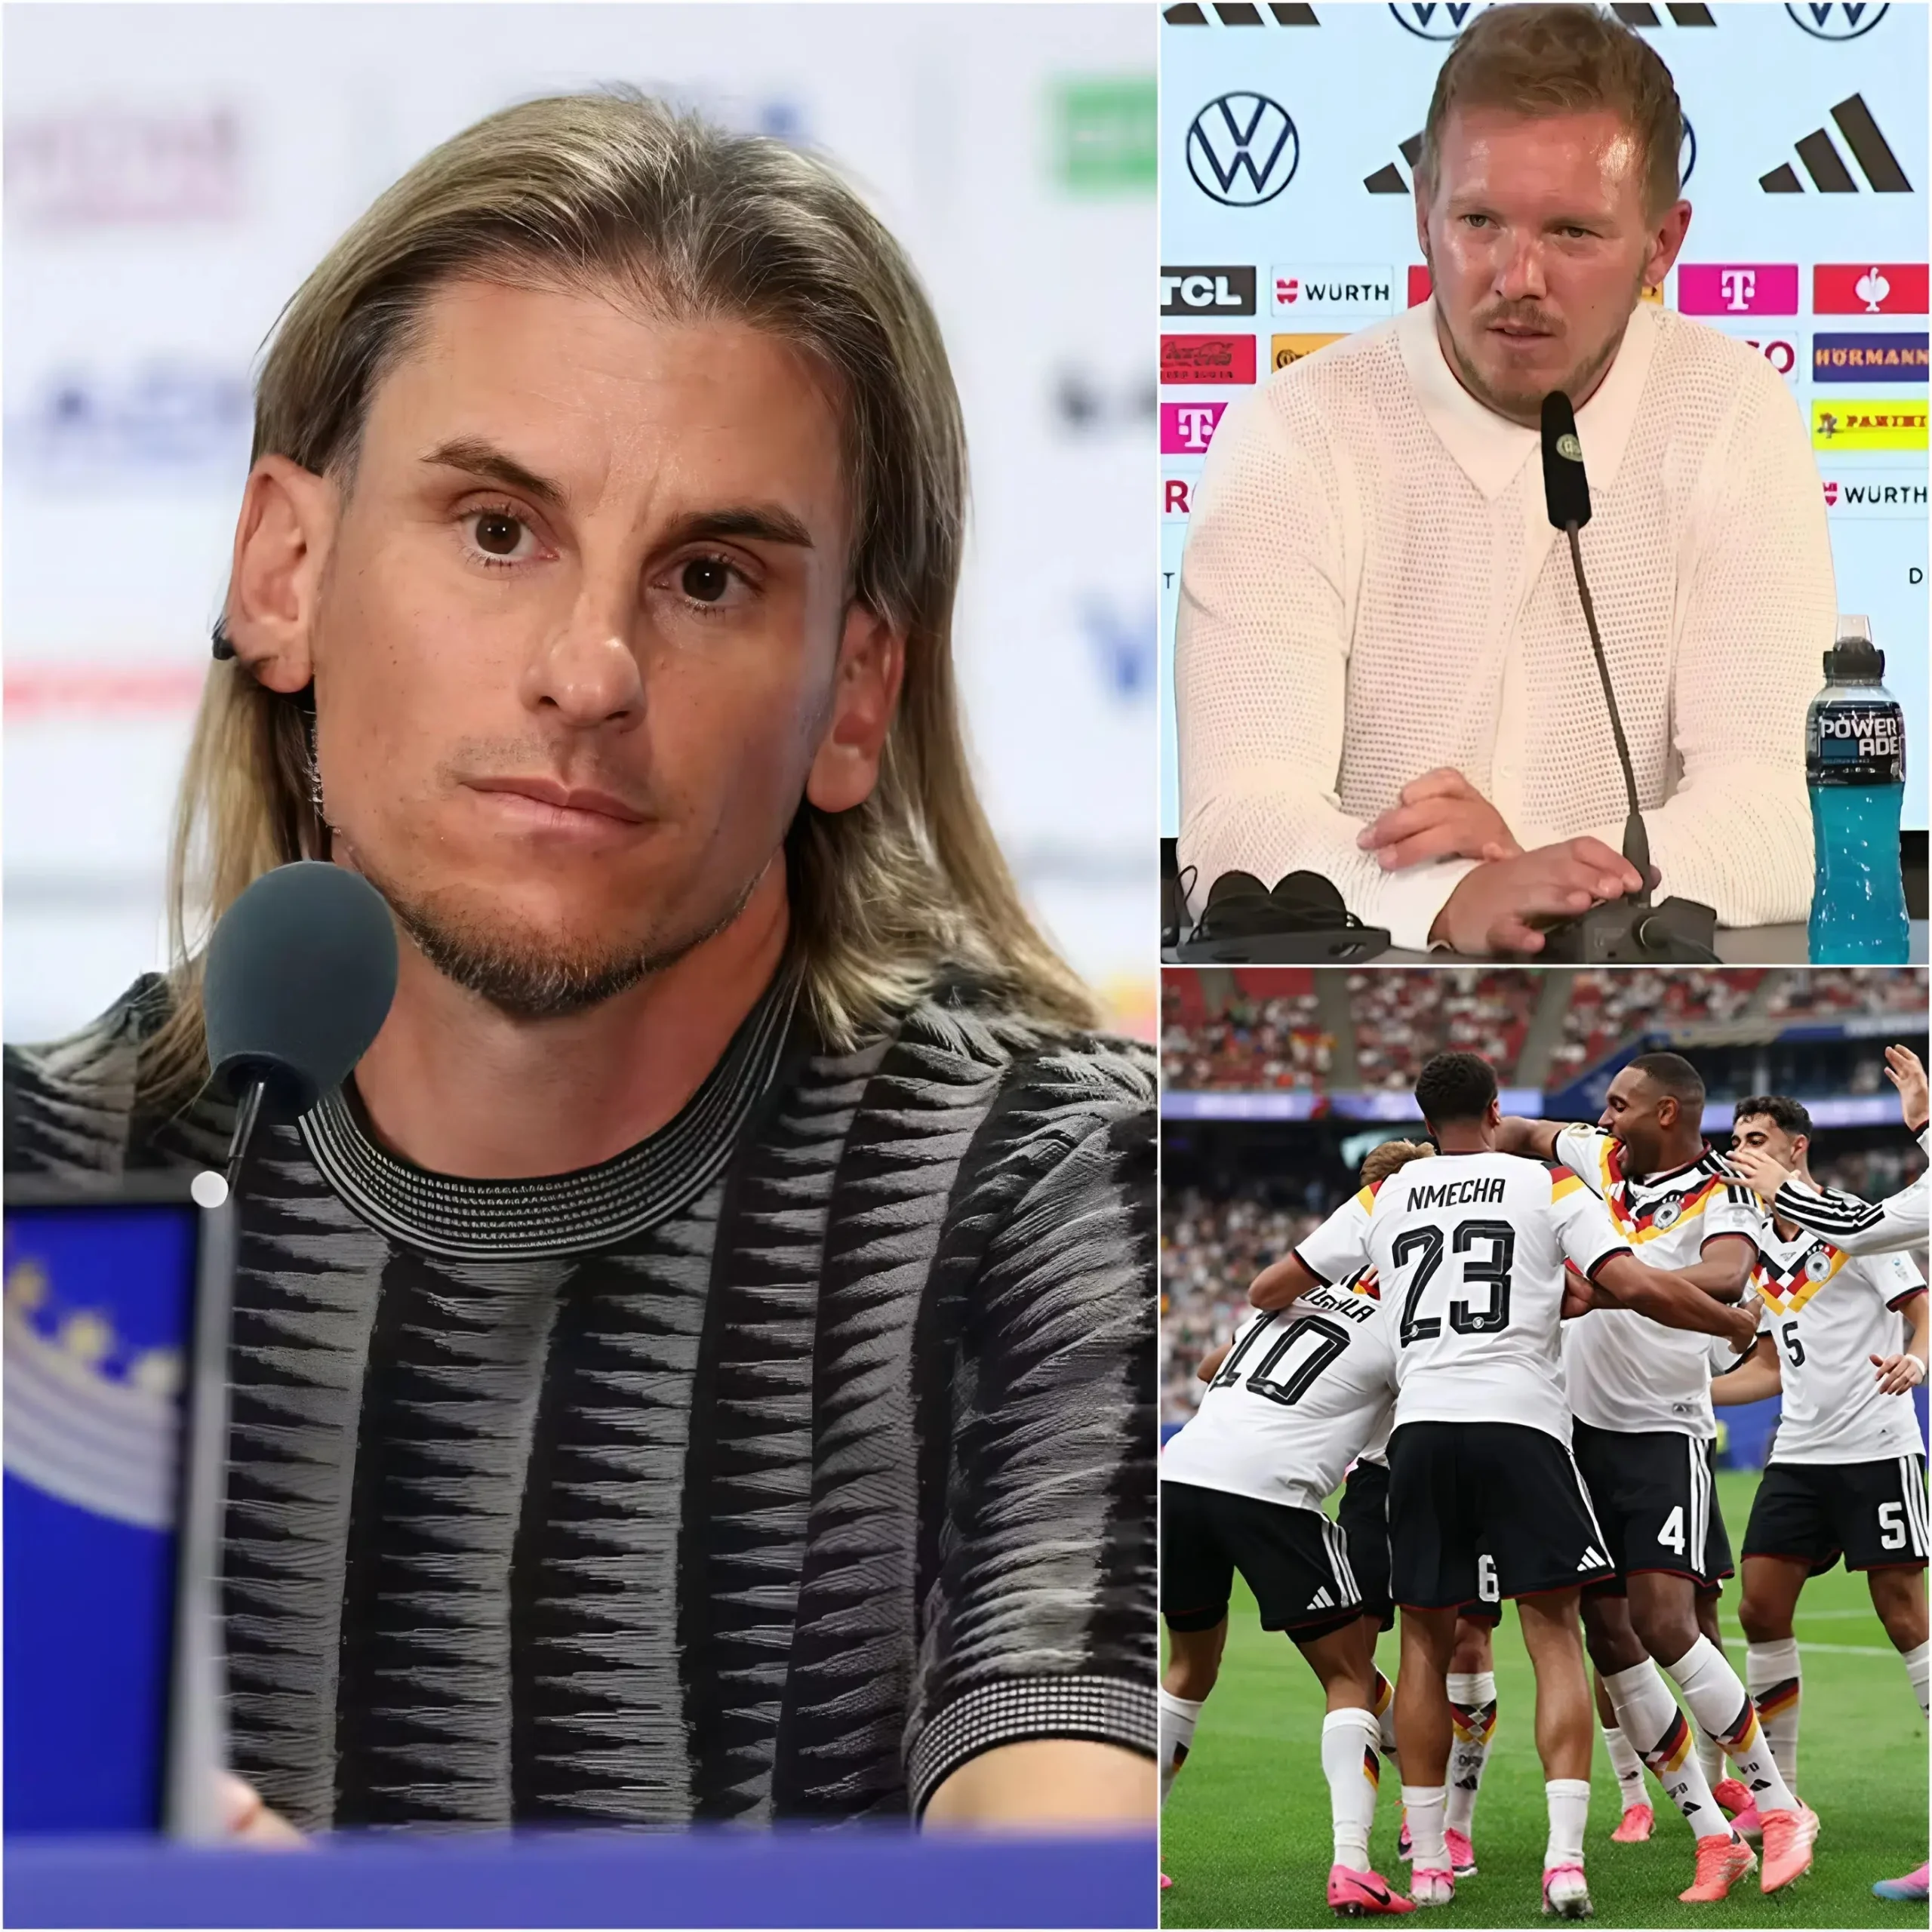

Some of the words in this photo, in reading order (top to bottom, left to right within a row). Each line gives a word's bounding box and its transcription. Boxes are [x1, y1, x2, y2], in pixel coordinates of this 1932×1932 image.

[1161, 275, 1241, 307] TCL
[1820, 717, 1897, 738] POWER
[1859, 737, 1900, 756] ADE
[1407, 1177, 1506, 1212] NMECHA
[1392, 1219, 1515, 1349] 23
[1208, 1309, 1351, 1406] 10
[1782, 1321, 1806, 1367] 5
[1657, 1506, 1686, 1555] 4
[1878, 1502, 1907, 1550] 5
[1478, 1555, 1500, 1603] 6
